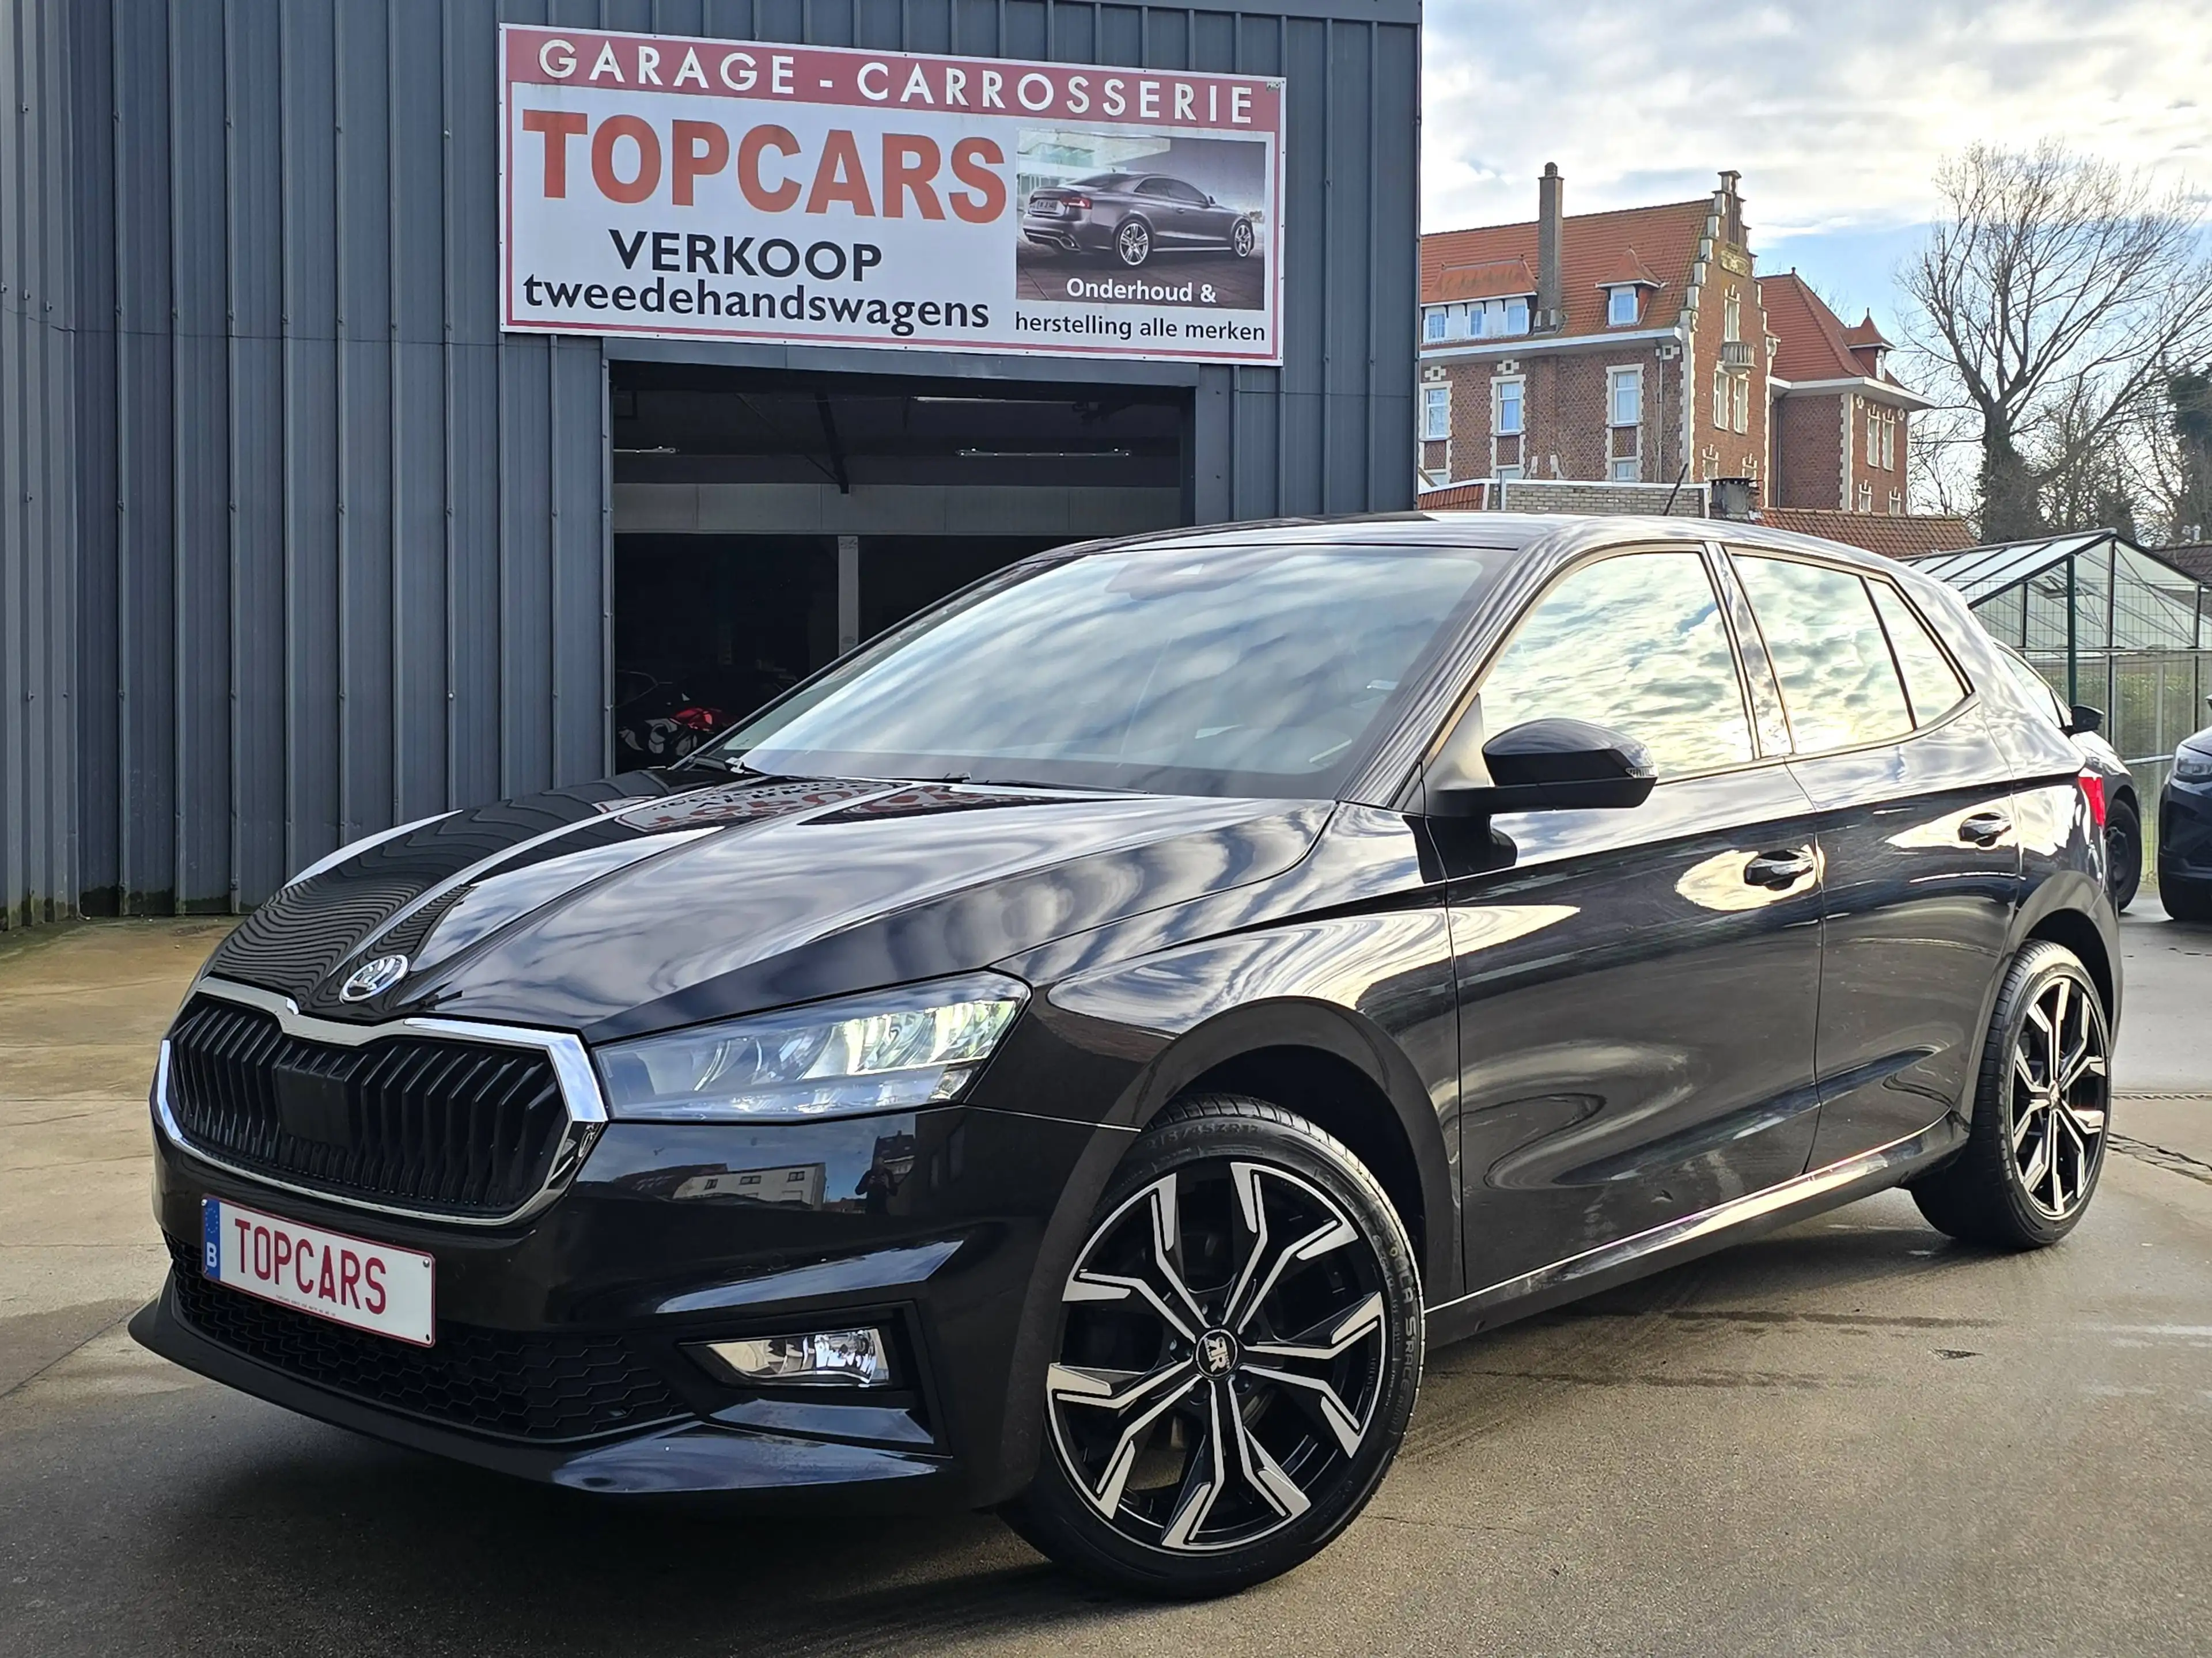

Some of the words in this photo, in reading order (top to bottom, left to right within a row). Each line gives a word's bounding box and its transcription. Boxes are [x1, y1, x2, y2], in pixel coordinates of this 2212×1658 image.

[538, 39, 794, 94] GARAGE
[857, 62, 1253, 124] CARROSSERIE
[522, 108, 1006, 223] TOPCARS
[608, 229, 882, 282] VERKOOP
[522, 274, 990, 336] tweedehandswagens
[1066, 277, 1192, 303] Onderhoud
[1200, 284, 1217, 303] &
[1015, 312, 1131, 340] herstelling
[1139, 317, 1177, 337] alle
[1185, 321, 1265, 342] merken
[206, 1241, 217, 1268] B
[234, 1218, 386, 1315] TOPCARS
